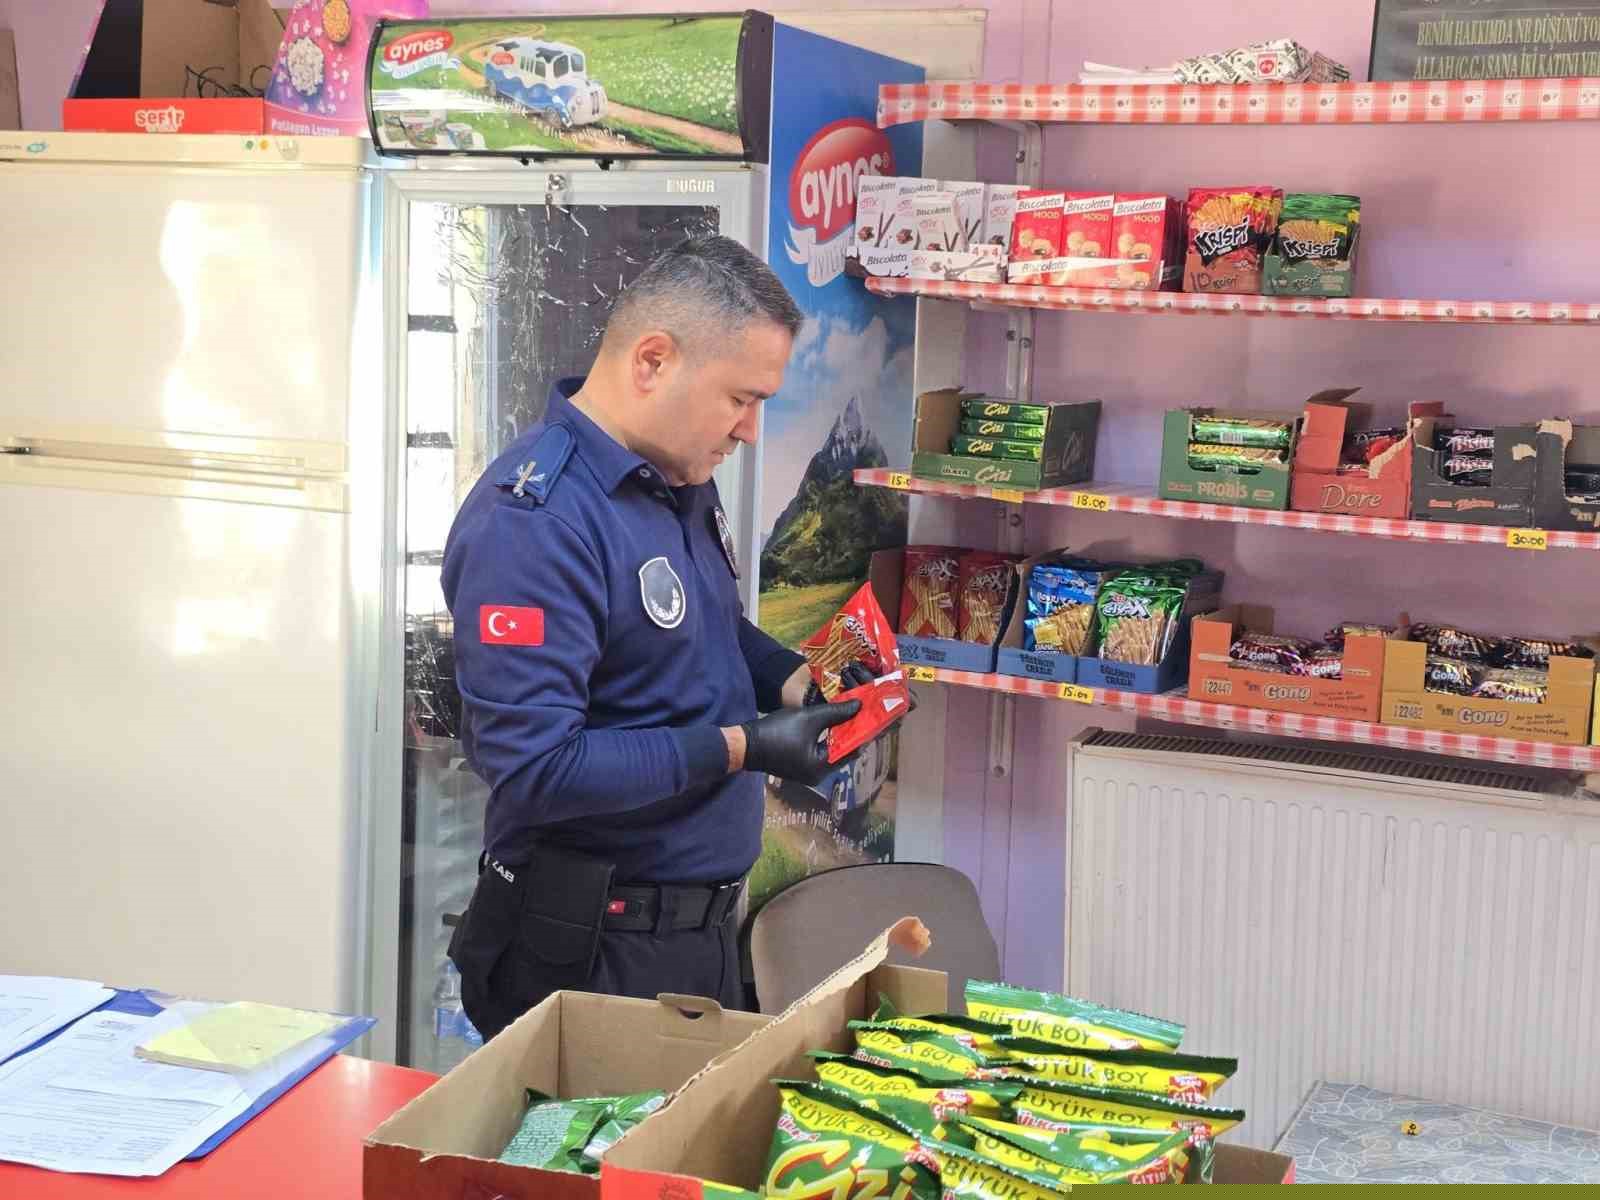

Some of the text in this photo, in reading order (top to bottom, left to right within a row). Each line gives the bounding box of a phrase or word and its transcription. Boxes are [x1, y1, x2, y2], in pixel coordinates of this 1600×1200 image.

[390, 35, 446, 61] aynes
[1264, 684, 1312, 701] Gong
[1459, 708, 1510, 725] Gong
[1050, 1026, 1092, 1046] BOY
[1103, 1066, 1148, 1085] BOY
[787, 1095, 898, 1142] BÜYÜK BOY
[1103, 1110, 1151, 1125] BOY
